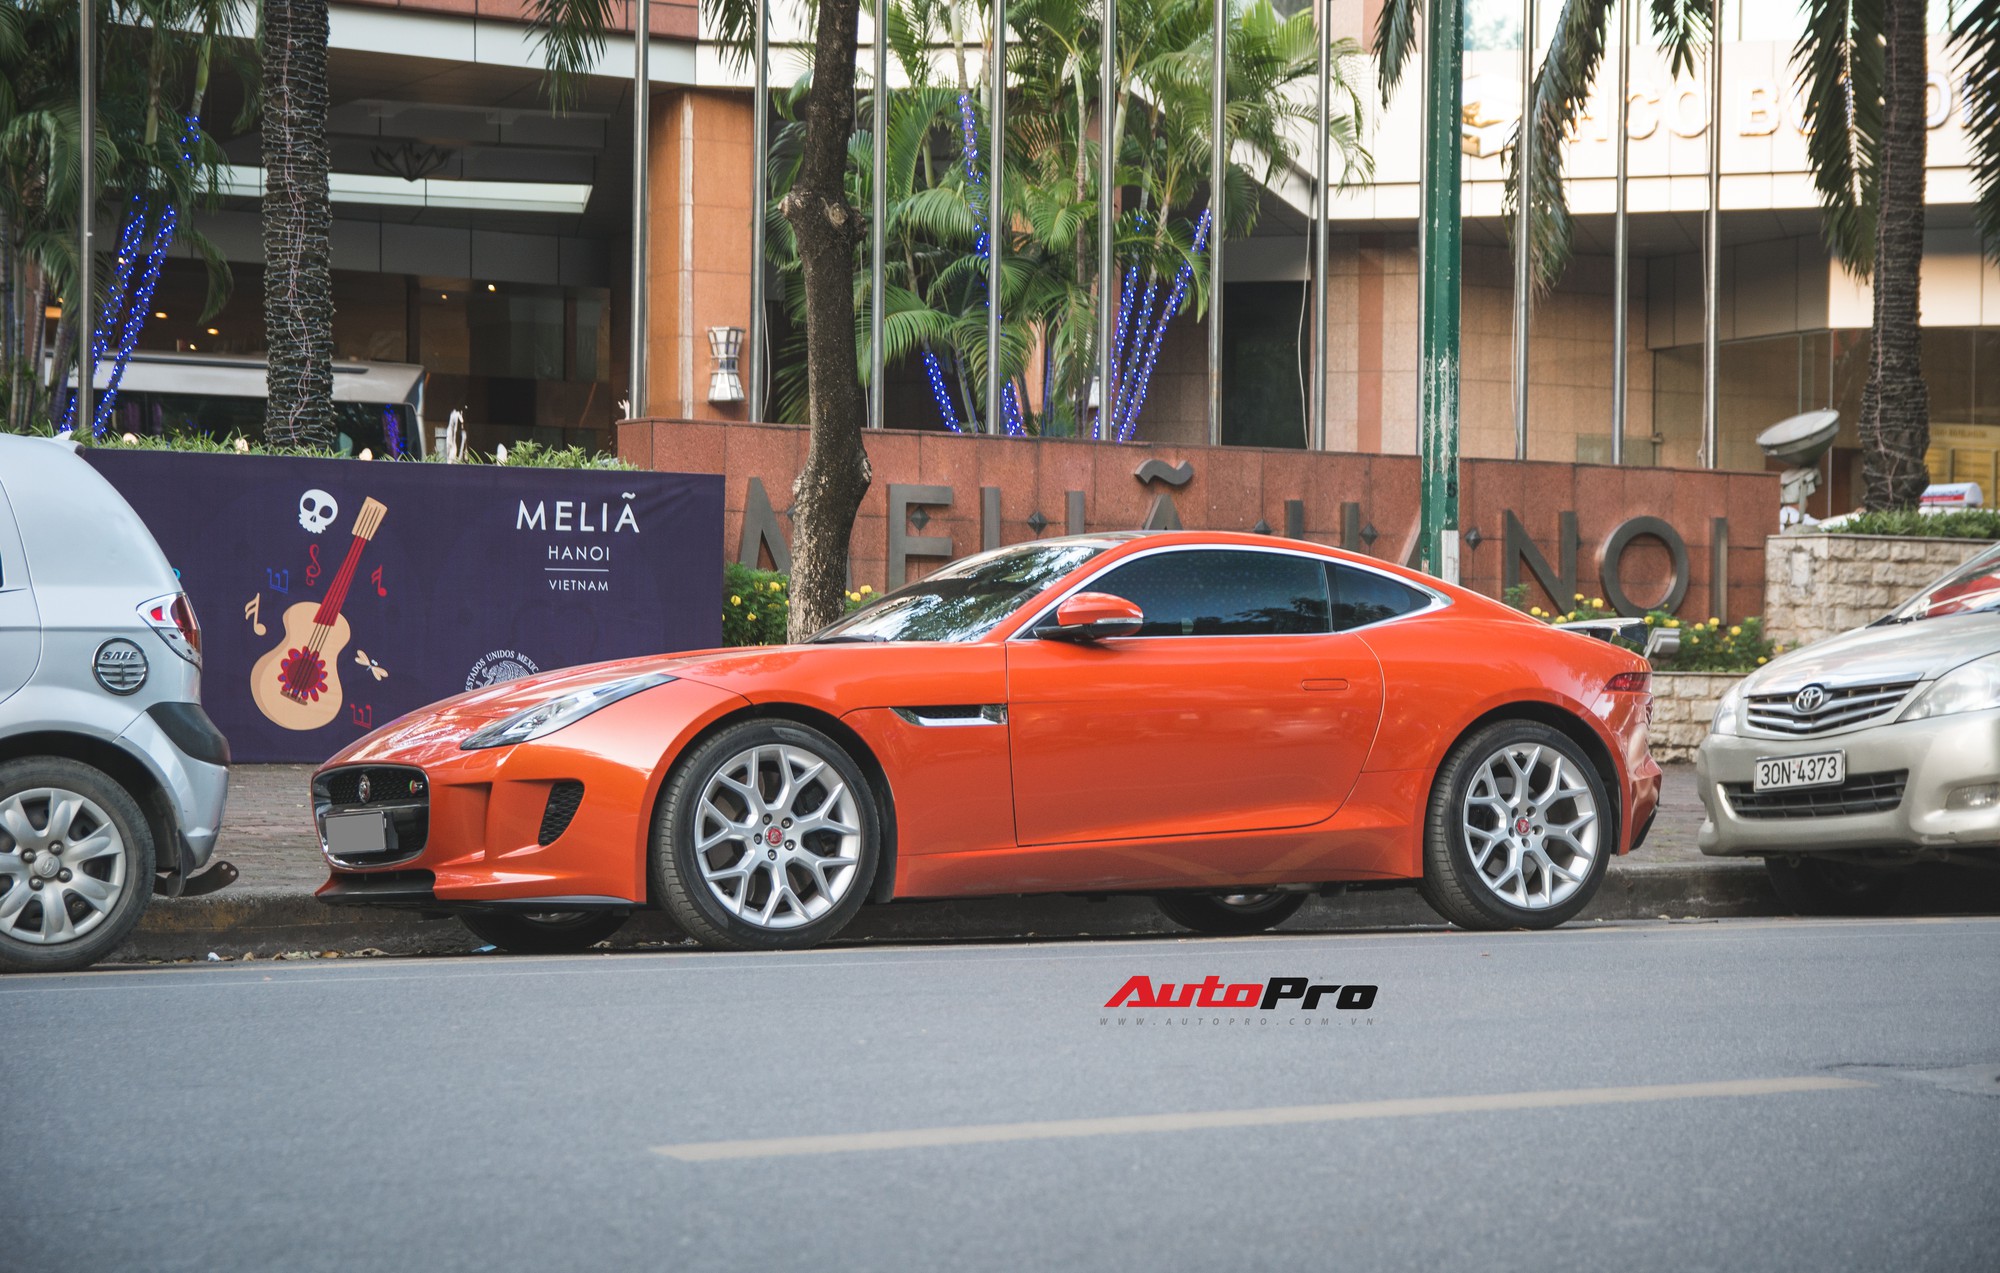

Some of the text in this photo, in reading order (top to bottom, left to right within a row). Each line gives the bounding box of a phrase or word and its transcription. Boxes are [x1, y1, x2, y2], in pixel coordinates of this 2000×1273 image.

[516, 491, 640, 533] MELIÃ
[548, 545, 610, 561] HANOI
[548, 579, 609, 591] VIETNAM
[101, 651, 138, 660] SAFE
[486, 649, 515, 662] UNIDOS
